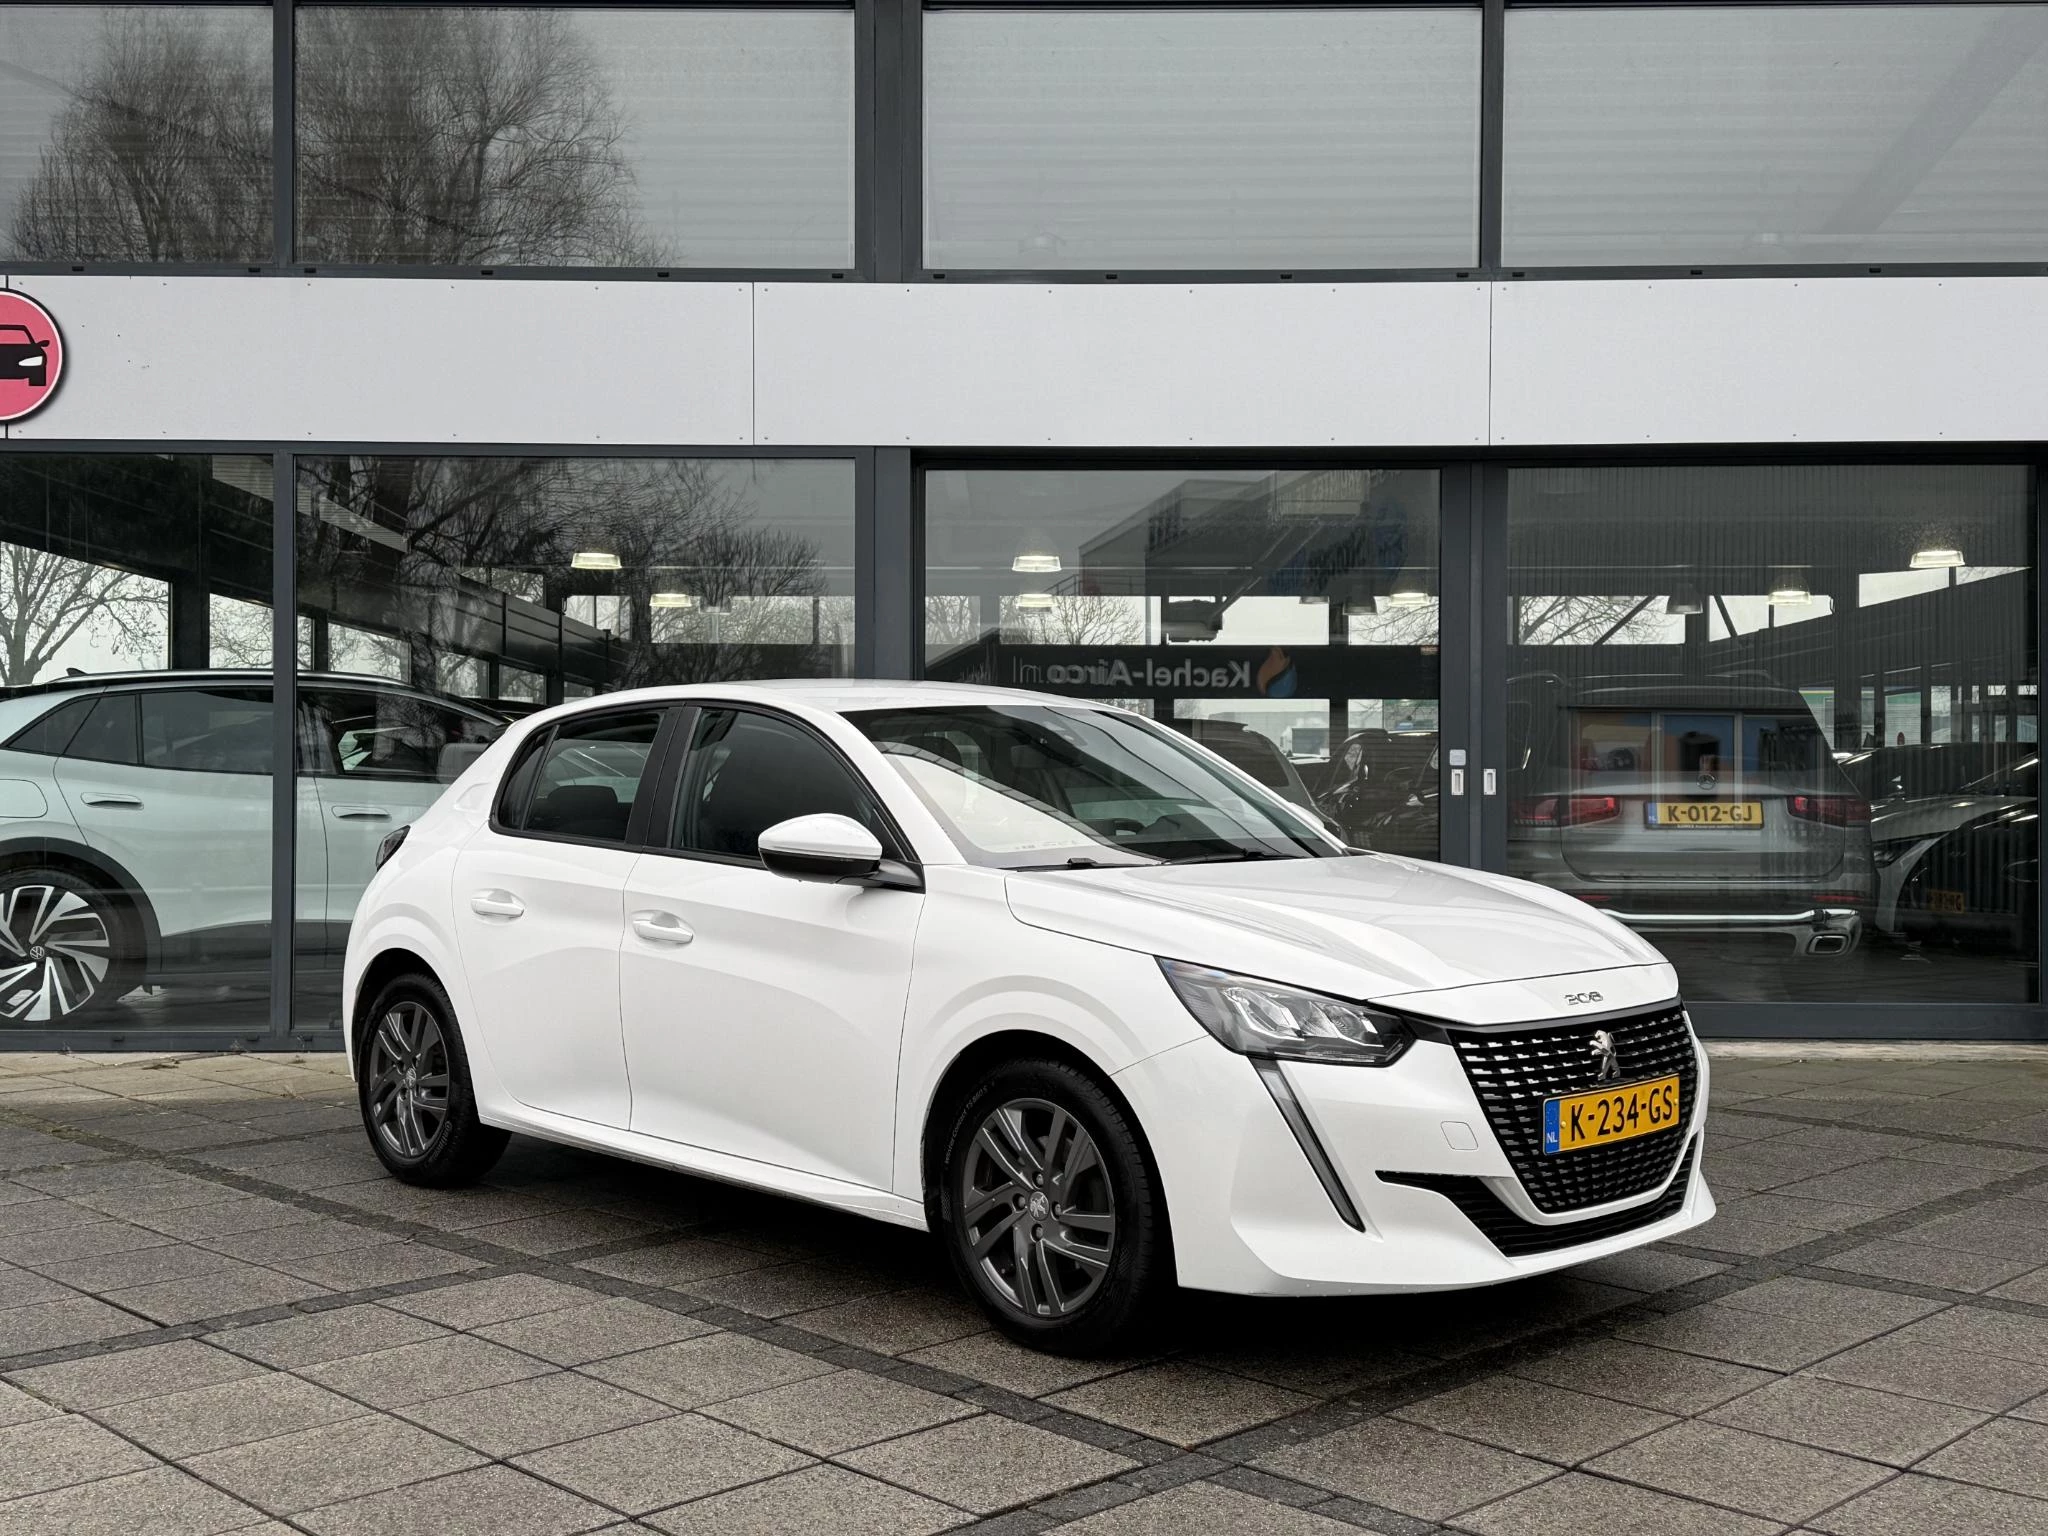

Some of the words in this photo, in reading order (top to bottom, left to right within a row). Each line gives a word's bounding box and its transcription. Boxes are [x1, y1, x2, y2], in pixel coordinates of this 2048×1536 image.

[1668, 805, 1753, 822] K-012-GJ
[1564, 991, 1604, 1005] 208
[1570, 1085, 1673, 1142] K-234-GS
[1546, 1131, 1558, 1144] NL
